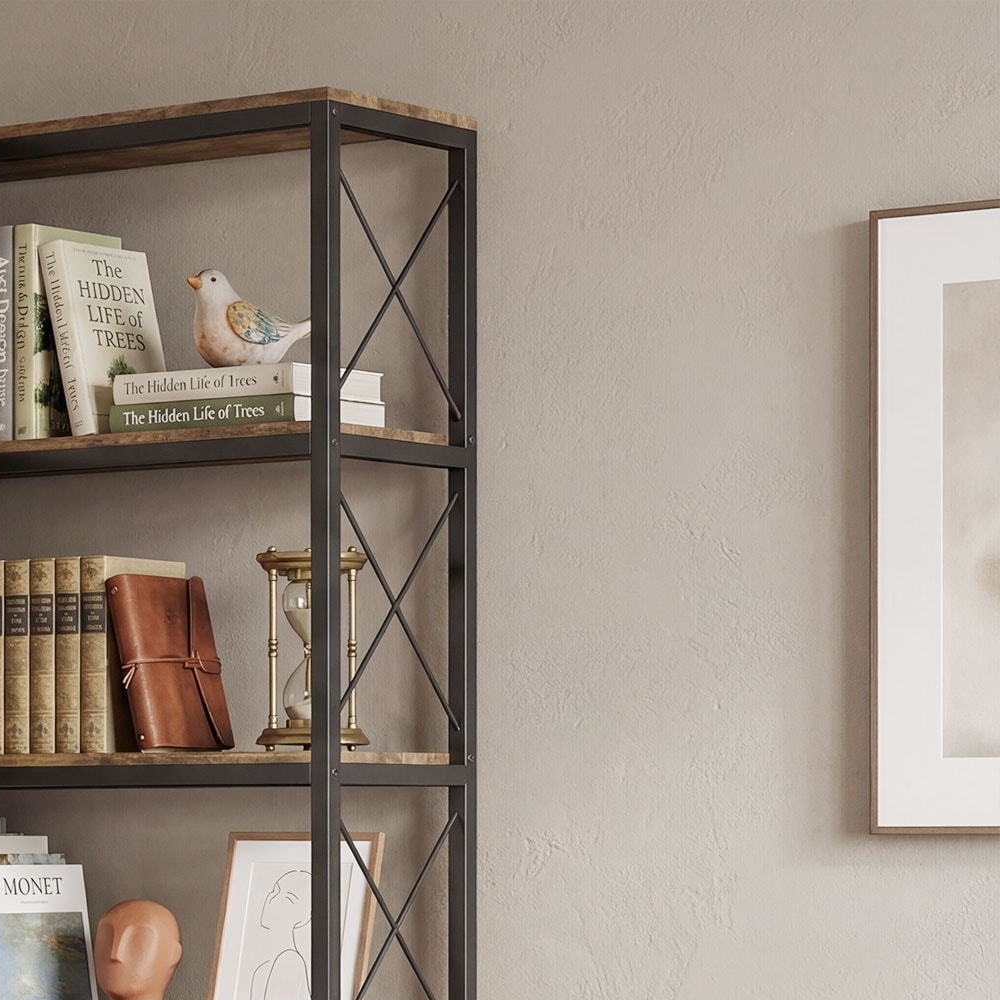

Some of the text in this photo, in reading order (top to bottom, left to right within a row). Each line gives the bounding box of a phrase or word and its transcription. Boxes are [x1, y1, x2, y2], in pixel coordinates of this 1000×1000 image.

[92, 259, 122, 279] The
[77, 280, 145, 305] HIDDEN
[87, 304, 143, 328] LIFE of
[93, 329, 146, 351] TREES
[123, 382, 145, 395] The
[147, 377, 186, 394] Hidden
[213, 374, 226, 388] of
[123, 403, 265, 426] The Hidden Life of Trees
[3, 877, 63, 896] MONET
